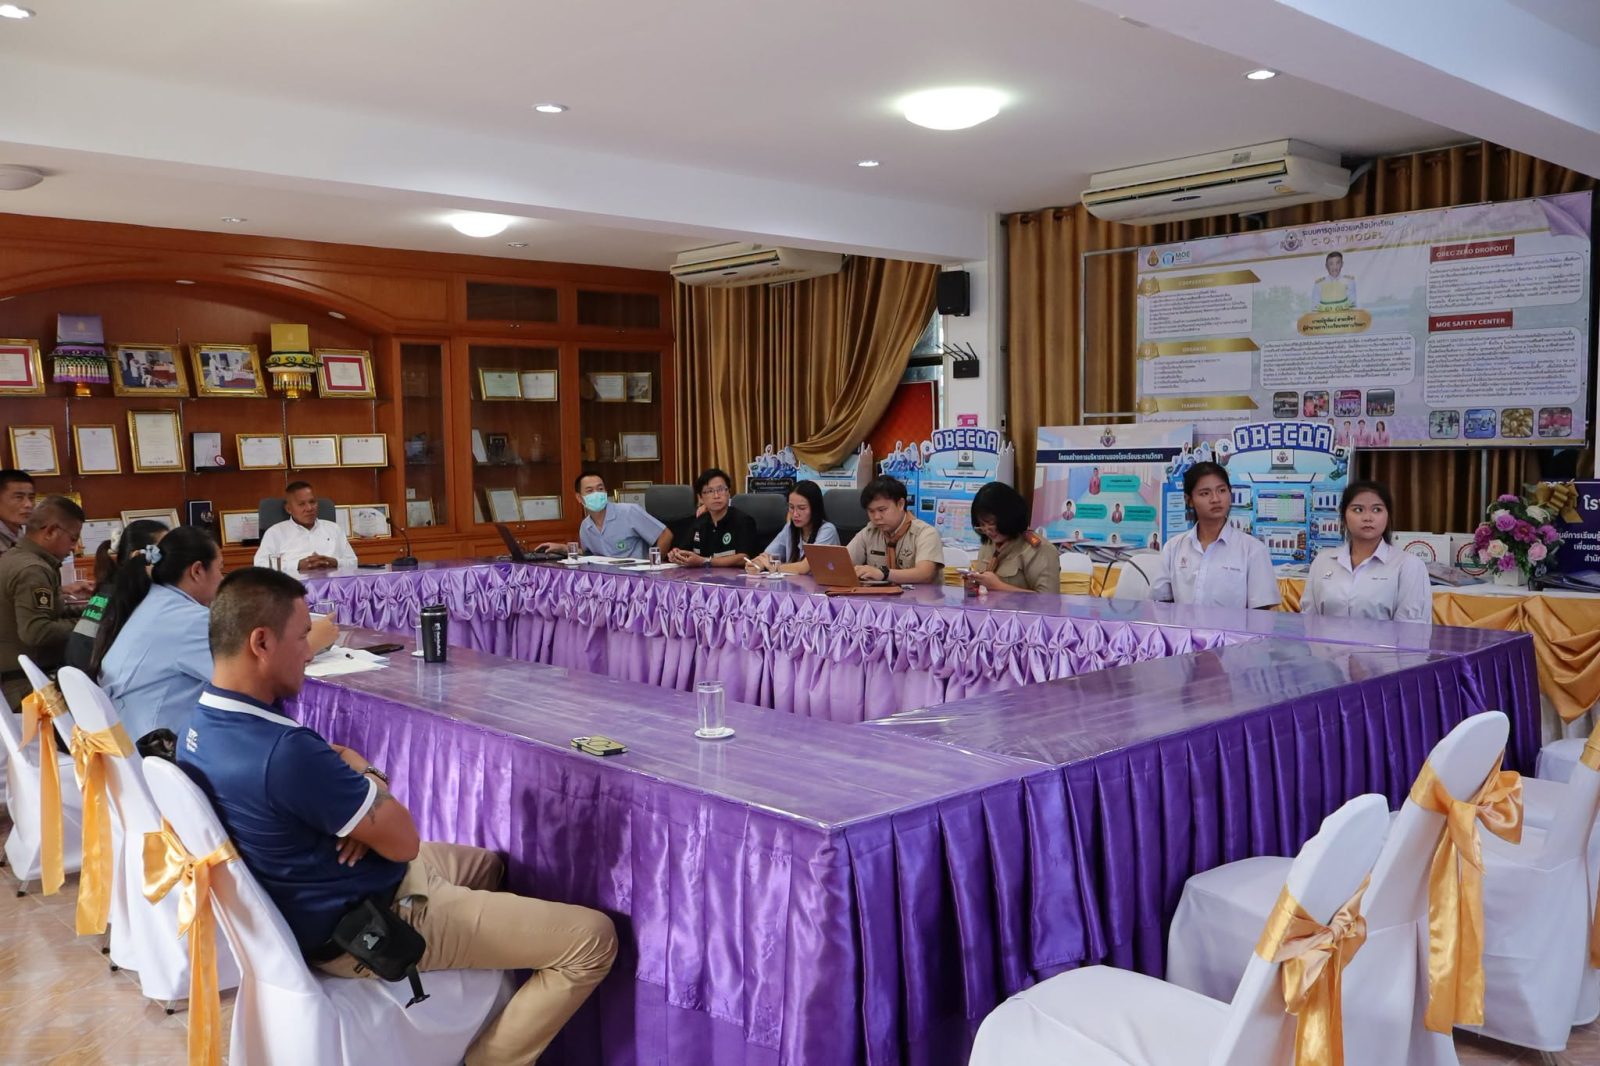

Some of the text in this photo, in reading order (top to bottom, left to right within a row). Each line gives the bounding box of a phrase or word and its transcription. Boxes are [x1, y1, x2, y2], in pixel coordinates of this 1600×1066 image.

[1345, 231, 1385, 243] MODEL
[1175, 250, 1191, 259] MOE
[1436, 244, 1509, 258] OBEC ZERO DROPOUT
[1435, 317, 1506, 329] MOE SAFETY CENTER
[934, 430, 997, 451] OBECQA
[1235, 423, 1331, 450] OBECQA
[1583, 494, 1600, 511] โร
